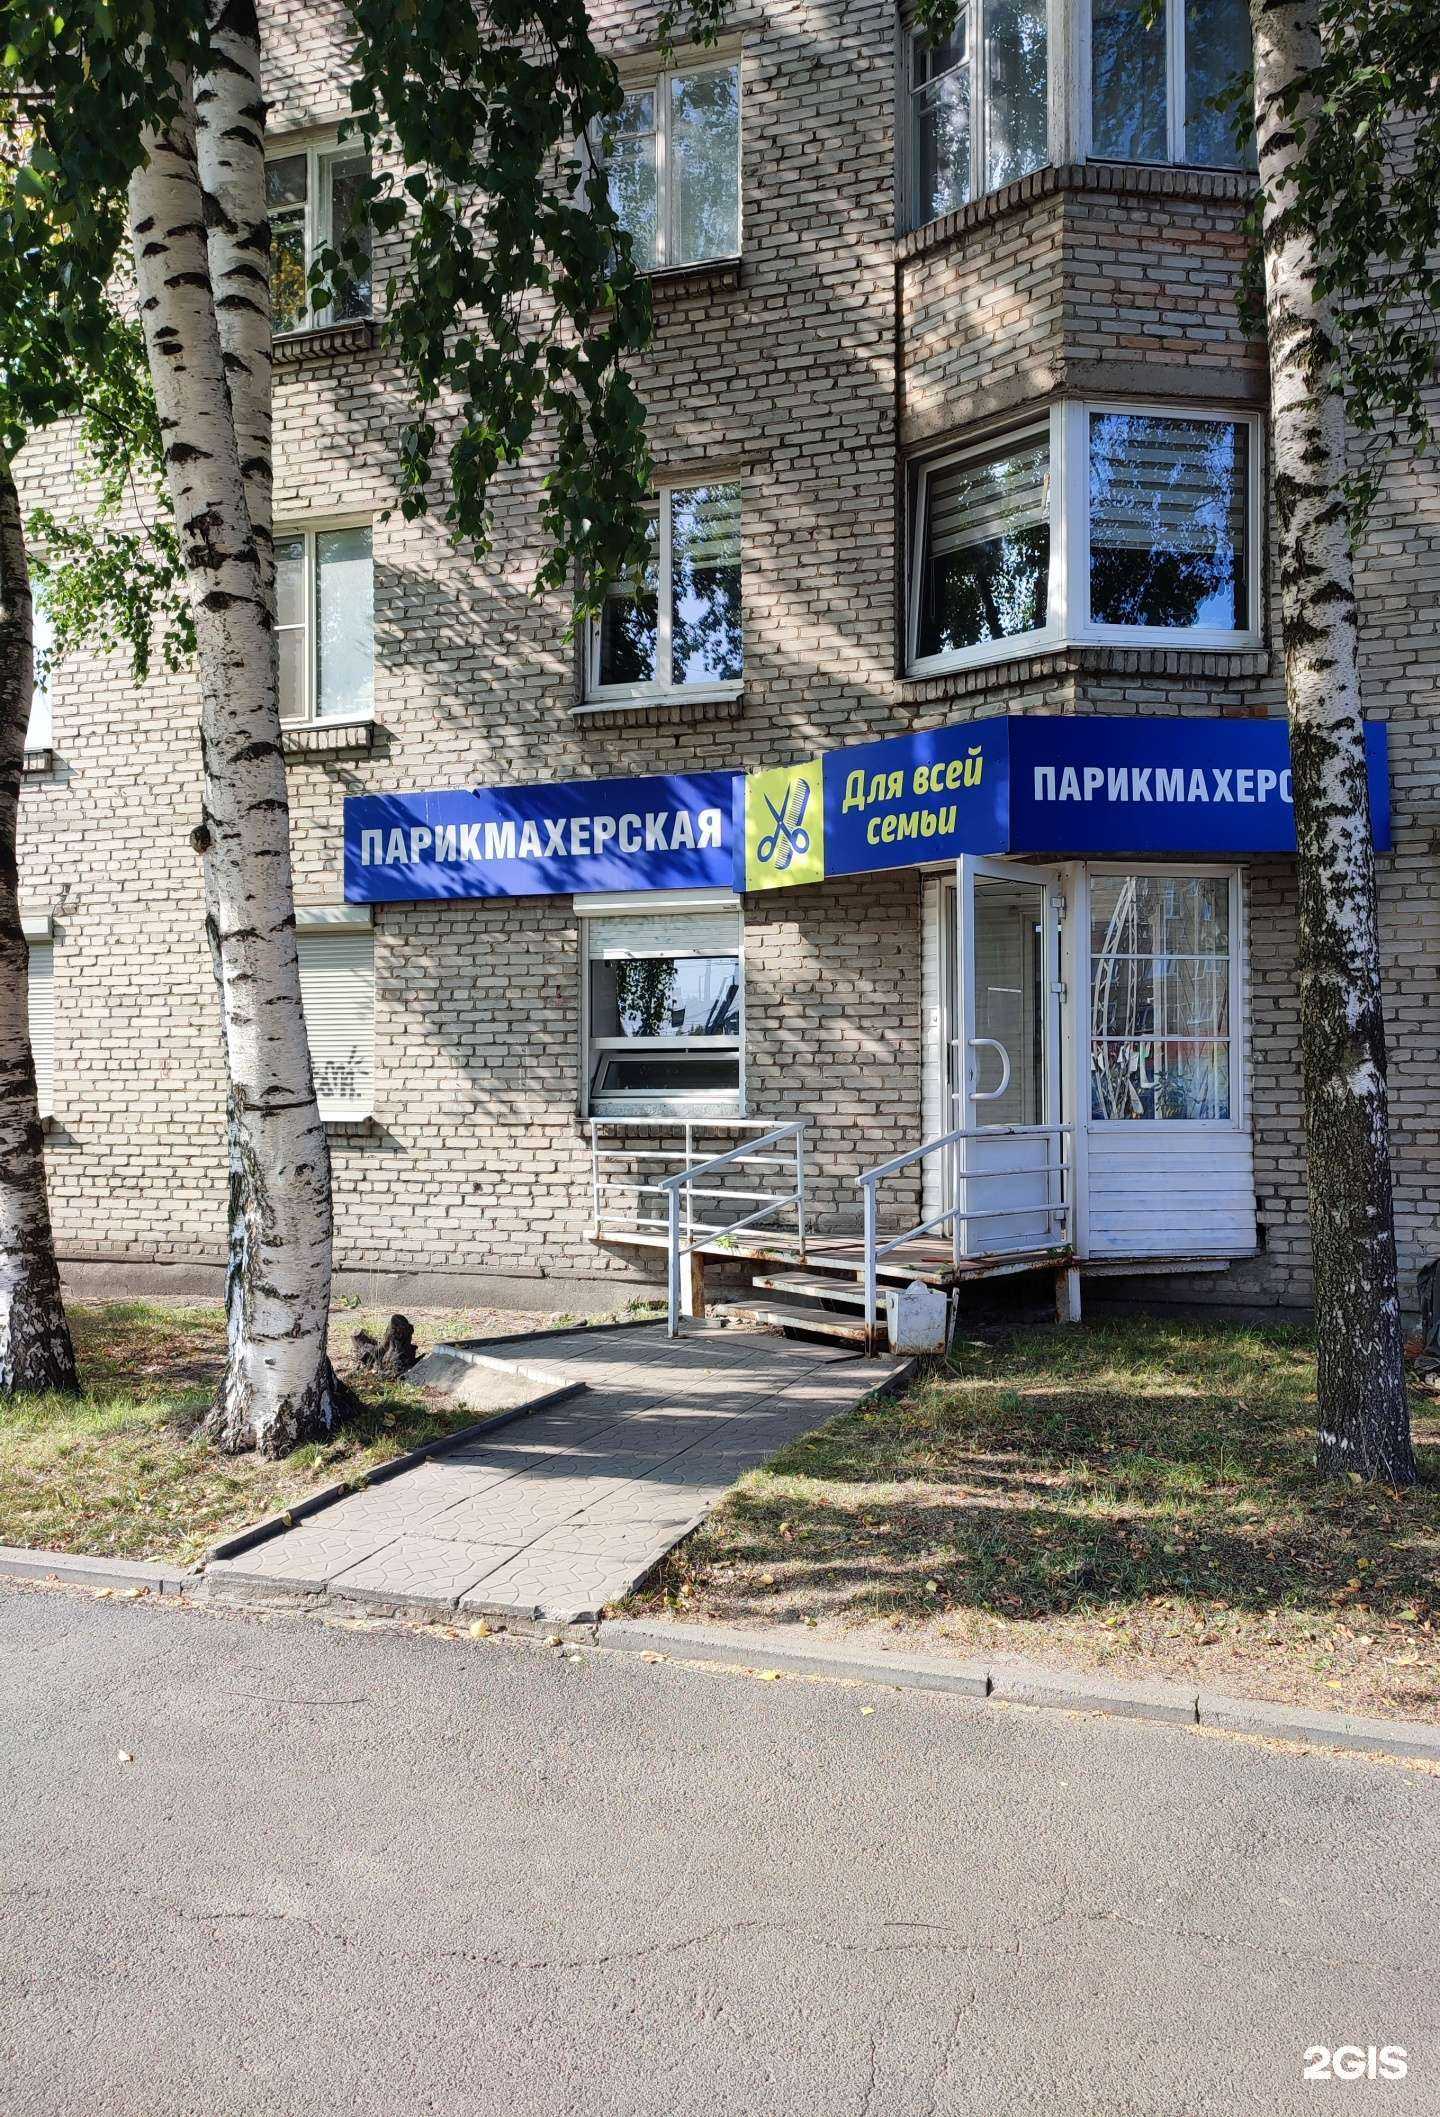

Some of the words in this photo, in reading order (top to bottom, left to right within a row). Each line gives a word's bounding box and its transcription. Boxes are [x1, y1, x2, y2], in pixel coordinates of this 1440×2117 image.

[842, 769, 904, 814] Для
[913, 745, 984, 795] всей
[361, 808, 722, 866] ПАРИКМАХЕРСКАЯ
[867, 805, 957, 845] семьи
